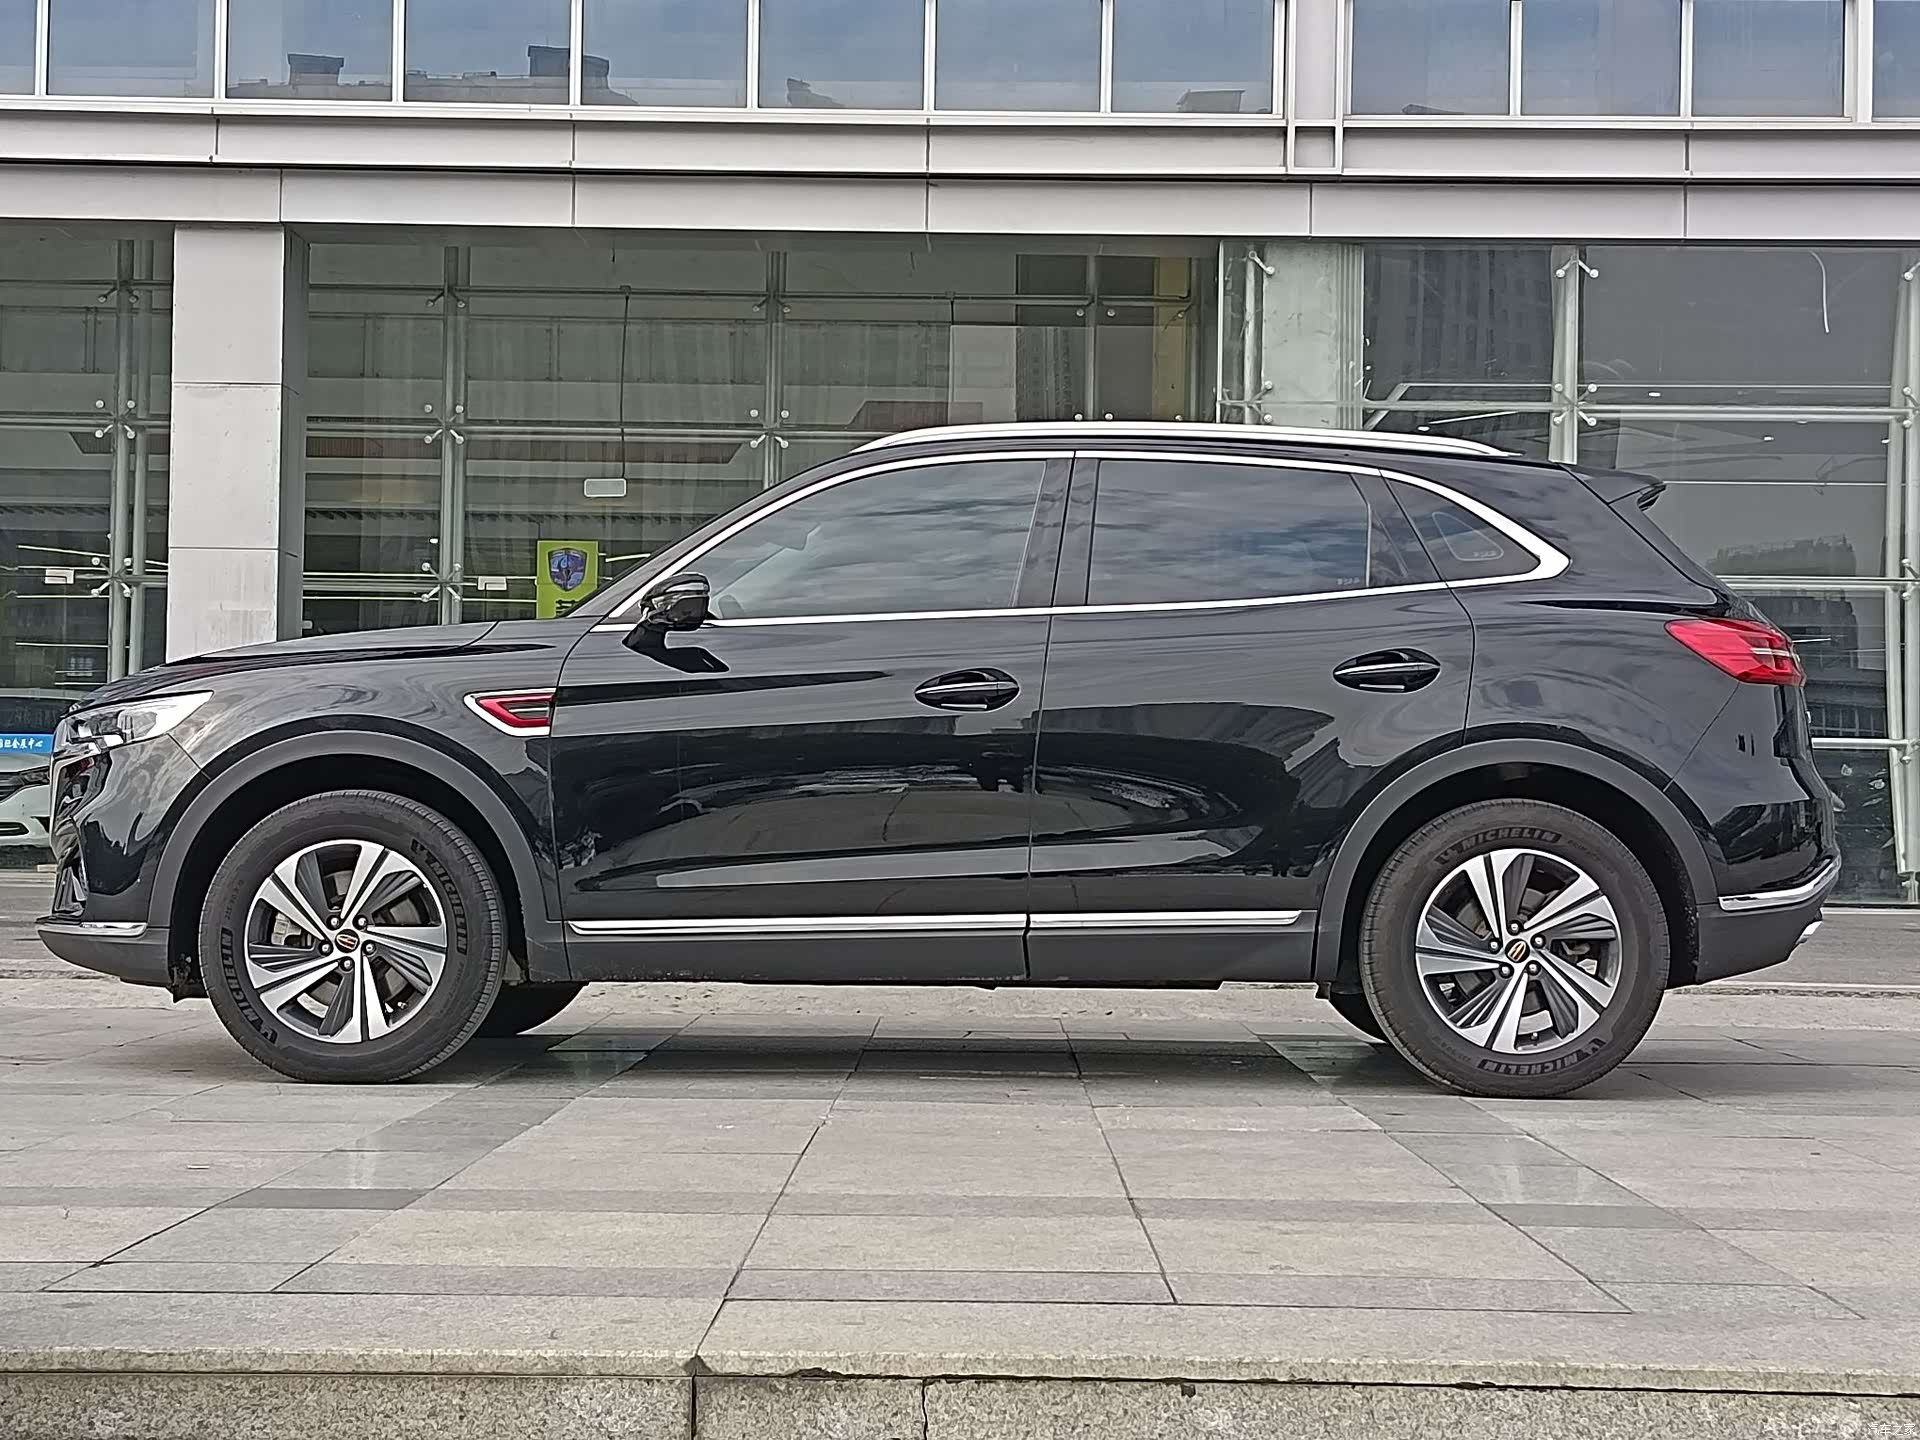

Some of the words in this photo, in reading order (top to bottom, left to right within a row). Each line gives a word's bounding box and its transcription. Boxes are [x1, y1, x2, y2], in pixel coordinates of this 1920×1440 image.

[1461, 827, 1557, 851] MICHELIN
[430, 860, 468, 951] MICHELIN
[221, 932, 260, 1021] MICHELIN
[1483, 1052, 1579, 1075] MICHELIN
